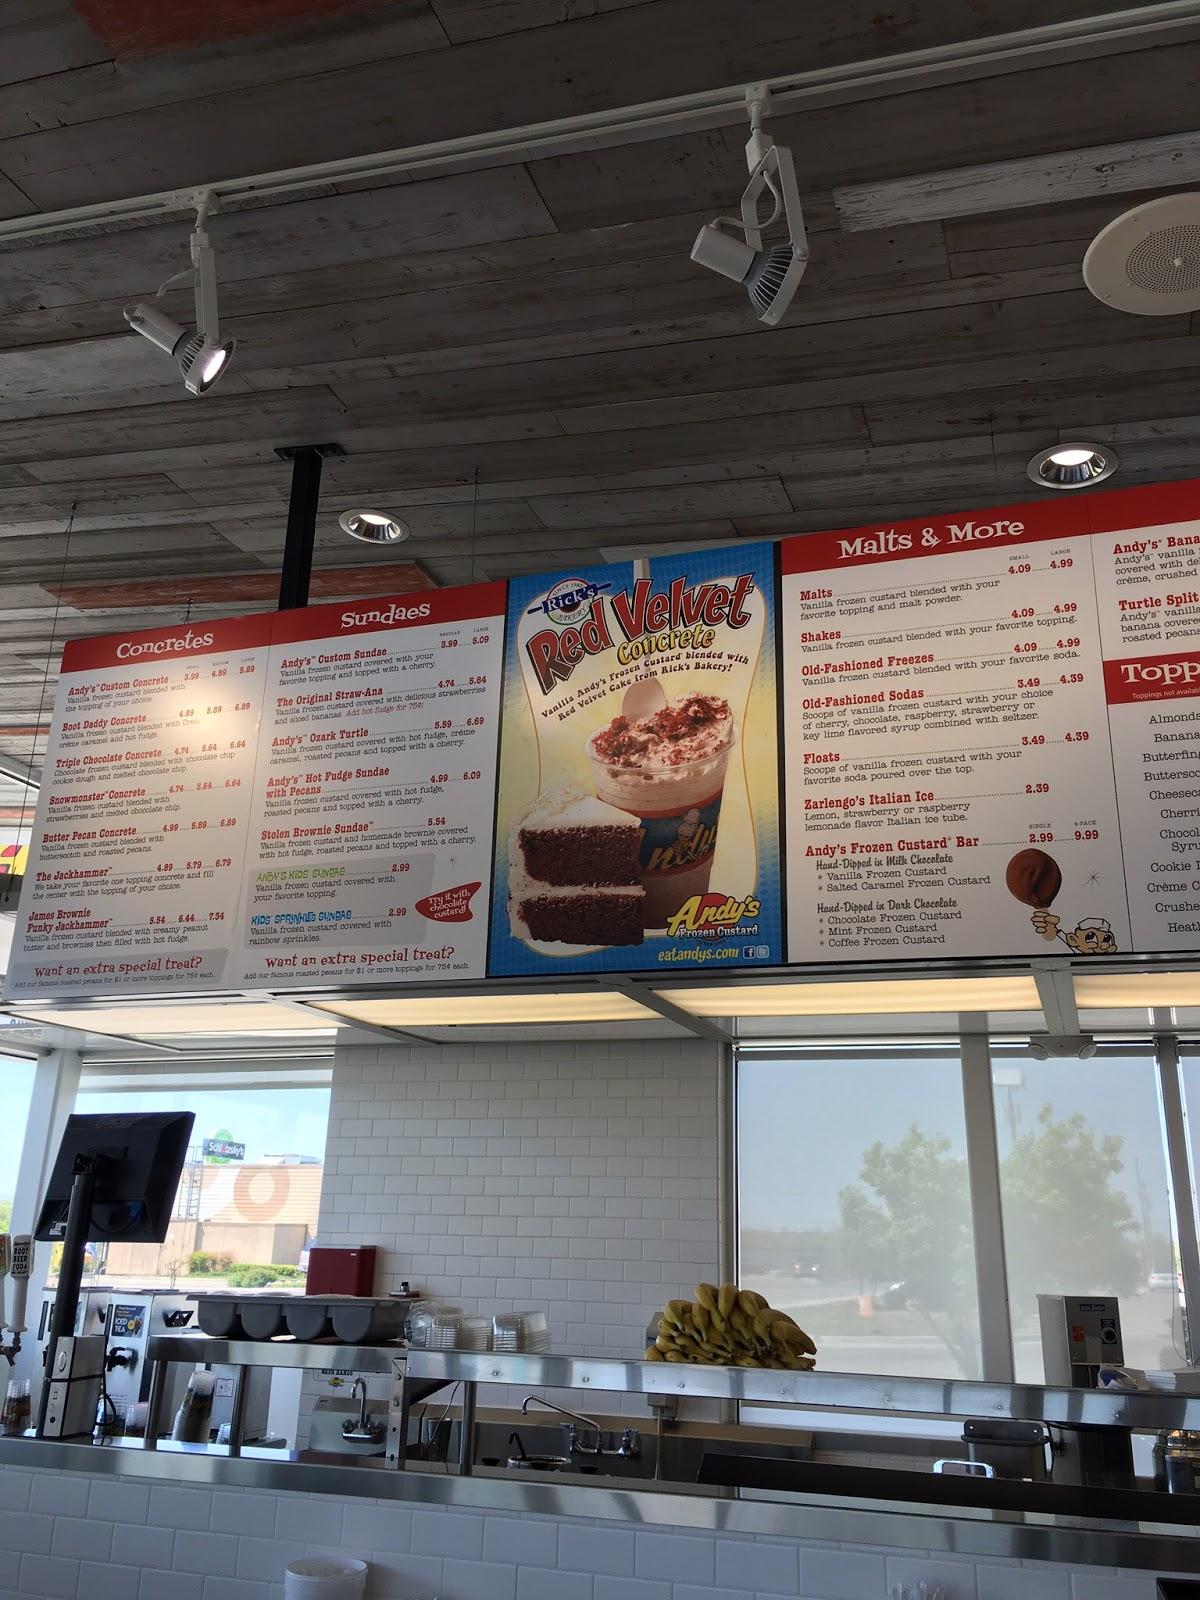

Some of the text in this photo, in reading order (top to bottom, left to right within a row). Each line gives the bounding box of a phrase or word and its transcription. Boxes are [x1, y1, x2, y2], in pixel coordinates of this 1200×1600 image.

[837, 519, 1024, 559] Malts & More
[800, 558, 1073, 600] Malts 4.09 4.99
[547, 588, 595, 611] Rick's
[801, 579, 1000, 611] Vanilla frozen custard blended with your
[1119, 591, 1199, 611] Turtle Split
[340, 603, 431, 629] Sundaes
[801, 603, 1077, 643] Shakes 4.09 4.99
[116, 630, 214, 659] Concretes
[526, 572, 756, 696] Red Velvet
[1123, 631, 1161, 643] roasted
[802, 637, 1080, 676] Old-Fashioned Freezes 4.09 4.99
[277, 676, 487, 707] The Original Straw-Ana 4.74 5.84
[542, 695, 574, 719] Vanilla
[577, 678, 607, 697] Andy's
[609, 663, 640, 682] Frozen
[686, 651, 723, 660] blended
[728, 653, 749, 665] with
[559, 662, 732, 722] Red Velvet Cake from Rick's Bakery!
[803, 673, 1083, 710] Old-Fashioned Sodas 3.49 4.39
[1132, 688, 1163, 699] Toppings
[56, 757, 81, 768] Triple
[83, 753, 122, 765] Chocolate
[125, 749, 162, 761] Concrete
[804, 731, 1089, 764] Floats 3.49 4.39
[266, 771, 481, 798] with Pecans 4.99 6.09
[804, 783, 1049, 811] Zarlengo's Italian Ice 2.39
[43, 832, 70, 843] Butter
[72, 829, 97, 841] Pecan
[100, 827, 137, 838] Concrete
[163, 824, 179, 832] 4.99
[220, 818, 236, 827] 6.89
[261, 830, 290, 840] Stolen
[293, 825, 332, 838] Brownie
[805, 843, 846, 858] Andy's
[850, 841, 893, 854] Frozen
[956, 836, 979, 848] Bar
[1029, 832, 1053, 843] 2.99
[1074, 830, 1099, 841] 9.99
[37, 872, 52, 881] The
[157, 863, 173, 872] 4.89
[216, 859, 231, 867] 6.79
[816, 853, 954, 872] Hand-Dipped in Milk Chocolate
[827, 866, 947, 881] Vanilla Frozen Custard
[1151, 861, 1191, 873] Cookie
[827, 875, 991, 892] Salted Caramel Frozen Custard
[1147, 881, 1187, 893] Crème
[429, 889, 471, 905] Try it with
[430, 899, 467, 912] chocolate
[817, 897, 958, 914] Hand-Dipped in Dark Chocolate
[274, 912, 317, 923] SPRINKLES
[319, 910, 352, 921] SUNDAE
[388, 908, 406, 917] 2.99
[434, 905, 467, 919] custard!
[667, 895, 761, 937] Andy's
[679, 925, 758, 938] Frozen Custard
[828, 933, 945, 948] Coffee Frozen Custard
[658, 946, 739, 963] eatandys.com
[35, 956, 202, 977] Want an extra special treat?
